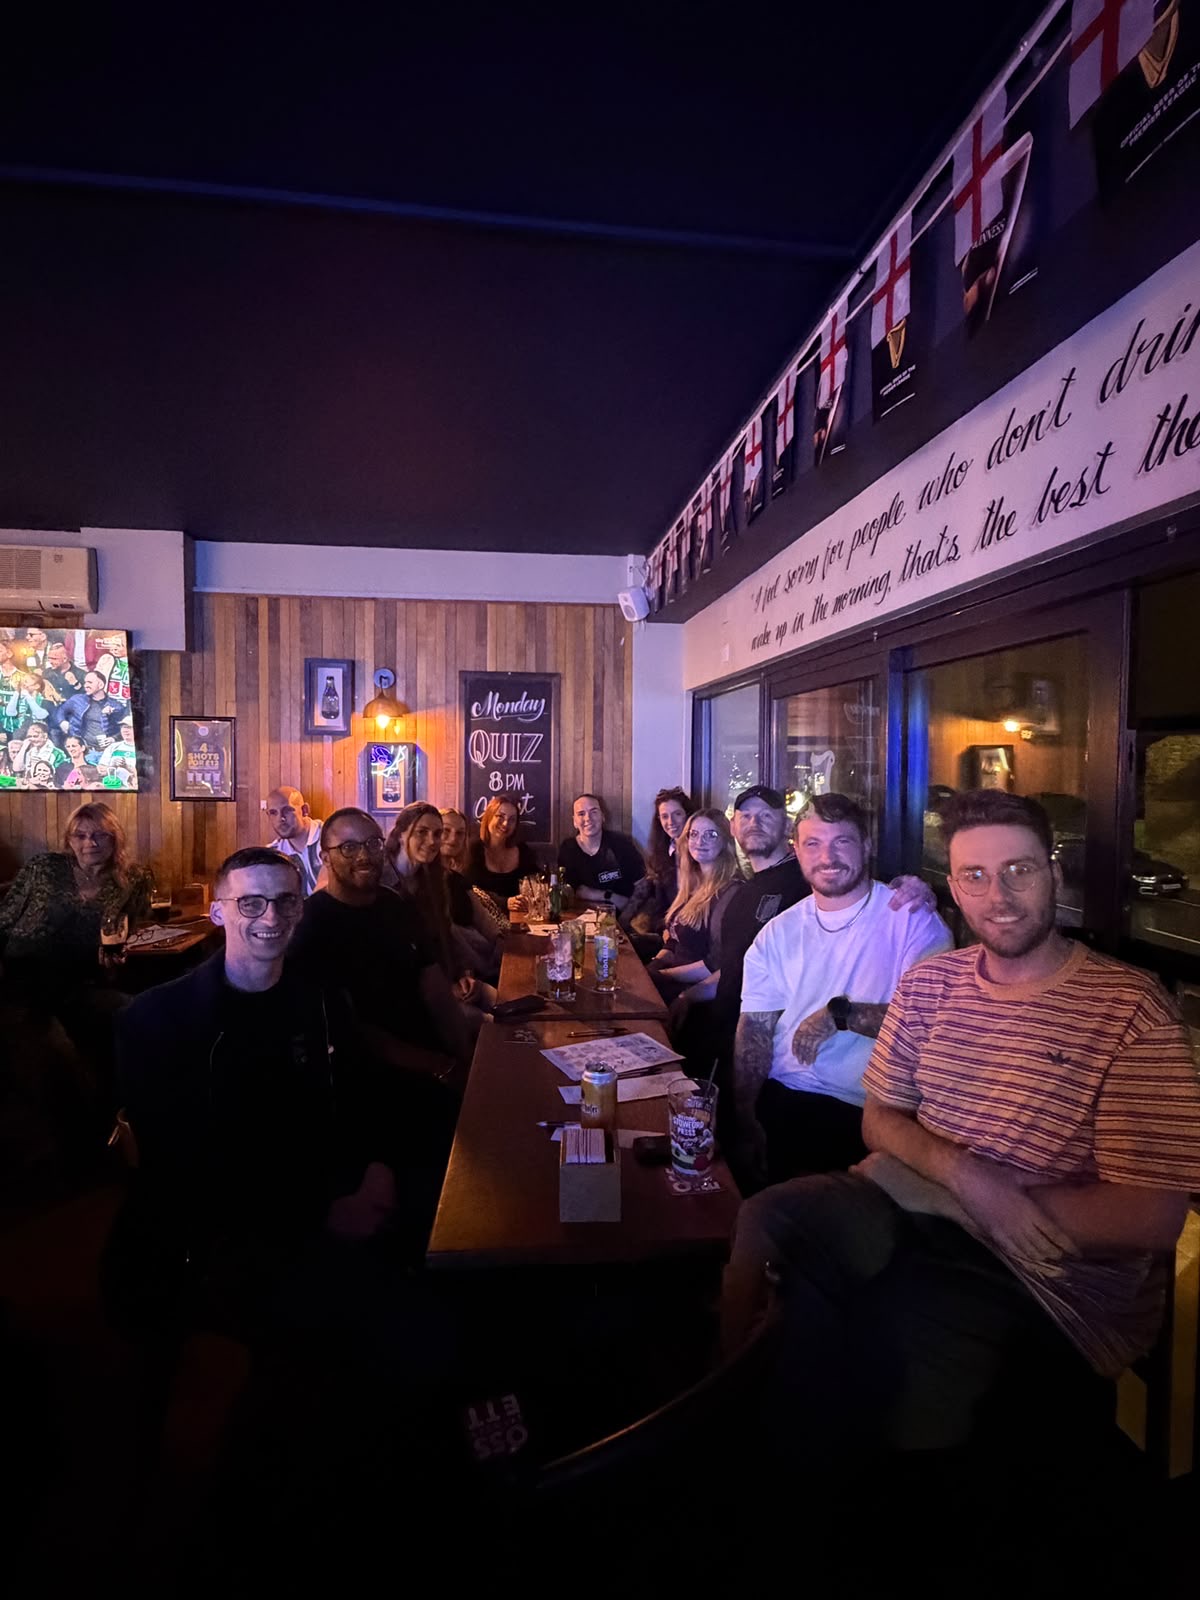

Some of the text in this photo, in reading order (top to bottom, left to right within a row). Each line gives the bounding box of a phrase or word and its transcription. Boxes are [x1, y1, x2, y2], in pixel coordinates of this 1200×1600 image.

[1153, 87, 1175, 112] BEER
[1162, 74, 1198, 112] LEAGUE
[761, 574, 781, 613] feel
[784, 555, 819, 593] sorry
[822, 539, 845, 580] for
[846, 492, 906, 570] people
[918, 452, 974, 511] who
[986, 367, 1076, 470] don't
[751, 621, 771, 651] wake
[775, 621, 788, 647] up
[792, 611, 805, 635] in
[810, 593, 829, 625] the
[831, 570, 892, 616] morning,
[898, 525, 961, 582] that's
[972, 496, 1018, 552] the
[1032, 441, 1118, 526] best
[470, 690, 546, 722] Monday
[187, 752, 220, 761] SHOTS
[468, 729, 544, 768] QUIZ
